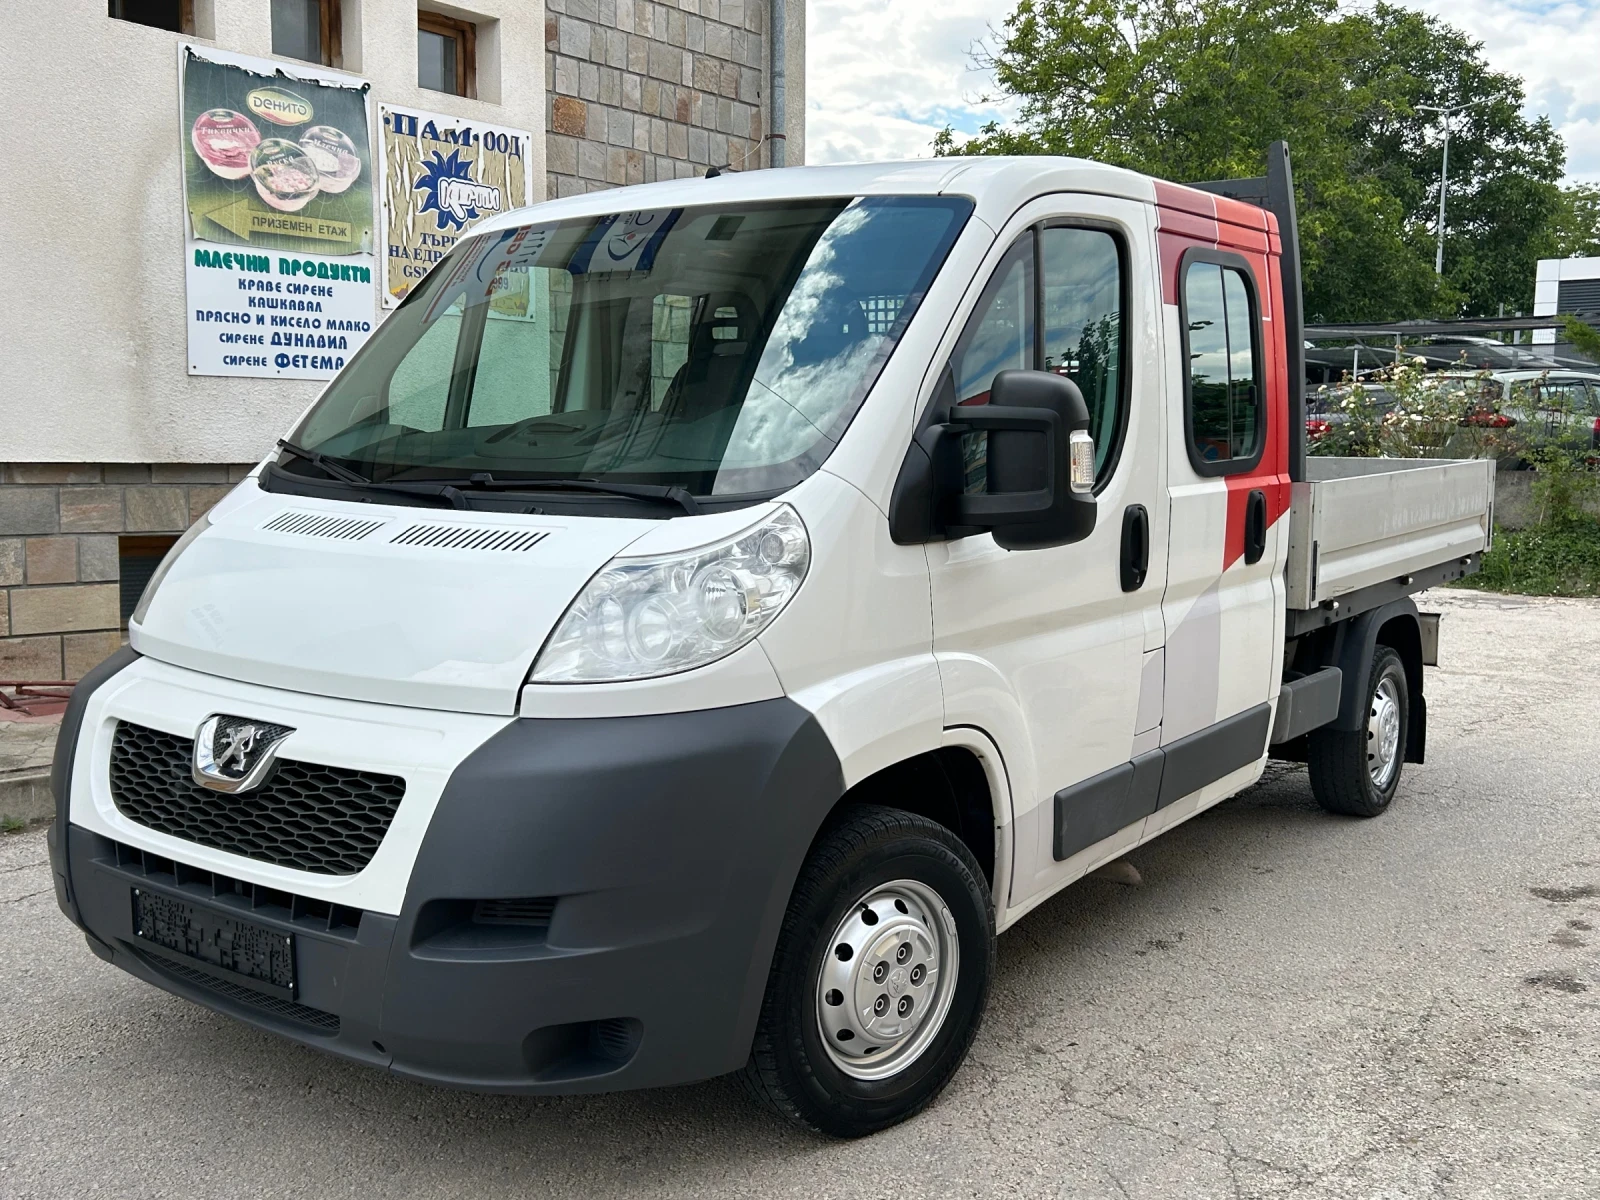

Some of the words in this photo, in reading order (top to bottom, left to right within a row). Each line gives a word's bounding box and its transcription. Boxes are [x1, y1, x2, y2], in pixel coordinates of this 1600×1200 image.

[391, 112, 473, 147] ПАМ
[483, 131, 521, 160] ООД
[252, 216, 313, 233] ПРИЗЕМЕН
[318, 224, 347, 237] ЕТАЖ
[389, 244, 409, 259] НА
[413, 247, 447, 265] ЕДР
[194, 249, 271, 274] МЛЕЧНИ
[278, 257, 371, 284] ПРОДУКТИ
[238, 278, 282, 293] КРАВЕ
[286, 283, 333, 297] СИРЕНЕ
[248, 296, 323, 313] КАШКАВАЛ
[196, 310, 251, 324] ПРЯСНО
[256, 314, 265, 326] И
[270, 315, 322, 329] КИСЕЛО
[326, 319, 371, 332] МЛЯКО
[219, 332, 264, 345] СИРЕНЕ
[223, 355, 267, 367] СИРЕНЕ
